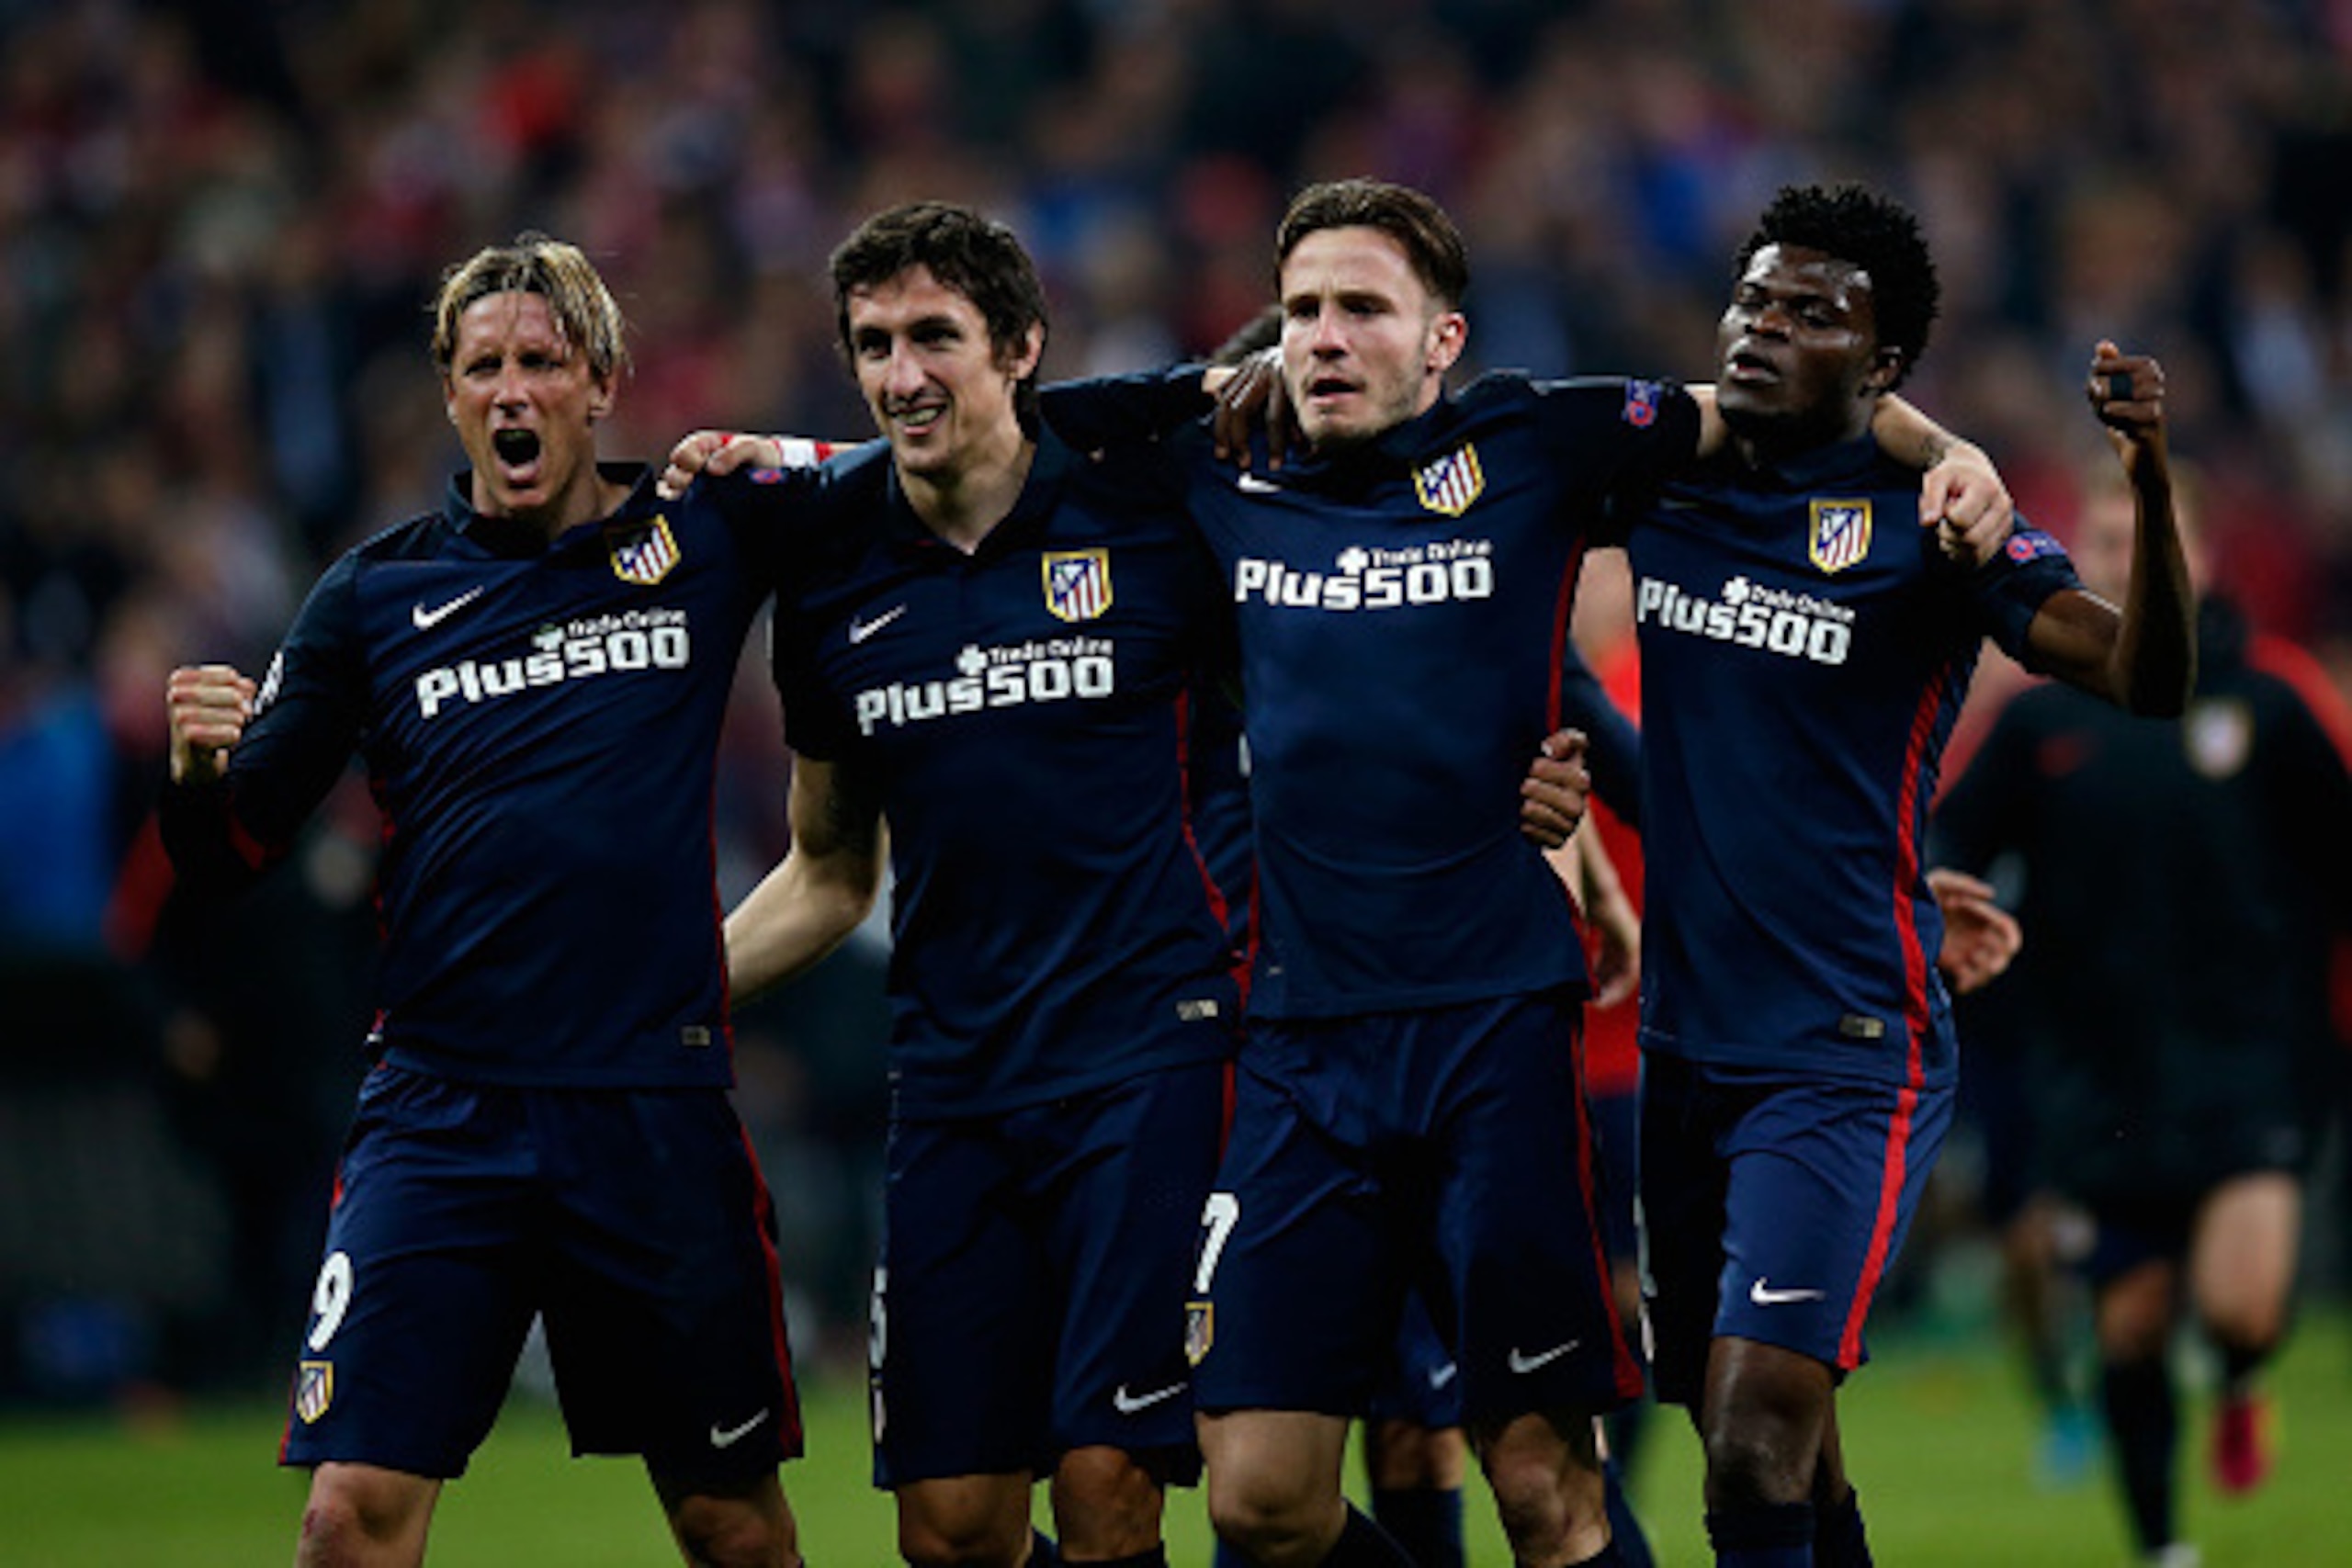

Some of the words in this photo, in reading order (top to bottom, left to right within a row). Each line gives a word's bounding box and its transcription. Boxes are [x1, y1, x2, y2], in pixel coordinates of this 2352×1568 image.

[1235, 556, 1493, 611] Plus500
[1637, 576, 1852, 665] Plus500
[416, 626, 689, 719] Plus500
[855, 656, 1114, 736] Plus500
[1194, 1193, 1240, 1294] 7
[308, 1250, 354, 1352] 9
